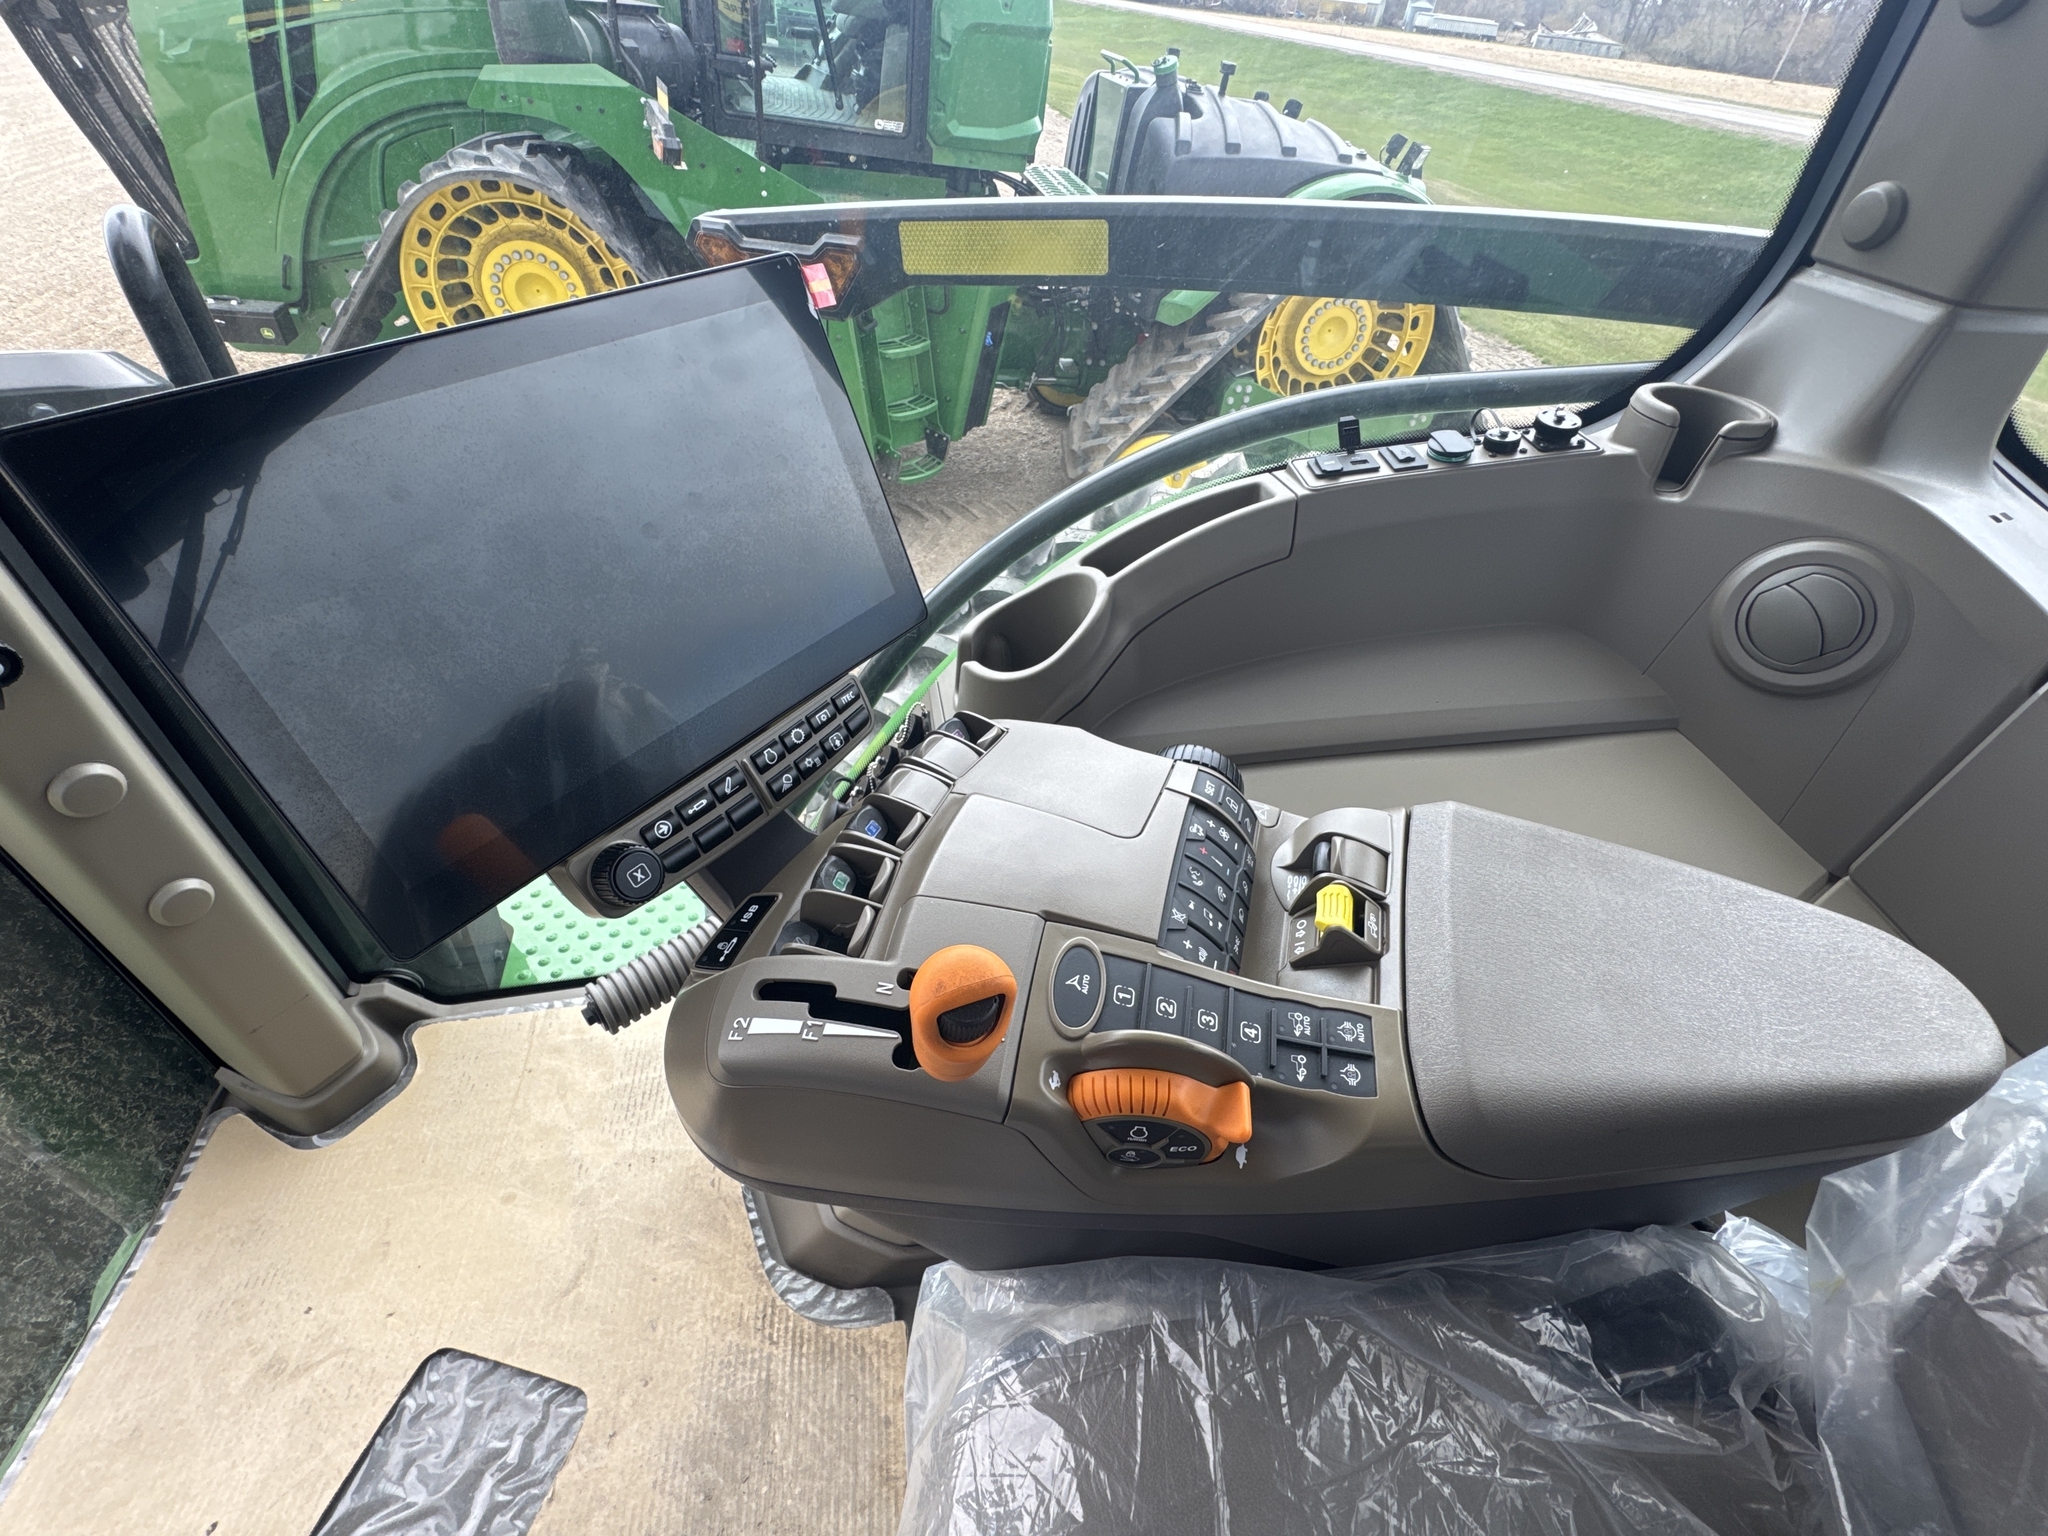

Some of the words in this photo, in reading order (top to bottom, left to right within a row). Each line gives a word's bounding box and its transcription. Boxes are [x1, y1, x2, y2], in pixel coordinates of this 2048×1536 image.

[1204, 780, 1216, 796] SET
[740, 904, 759, 923] ISB
[876, 982, 895, 995] N
[1081, 974, 1090, 994] AUTO
[1117, 992, 1131, 1000] 1
[1159, 1002, 1173, 1014] 2
[1201, 1015, 1215, 1026] 3
[1303, 1015, 1311, 1036] AUTO
[727, 1017, 750, 1041] F2
[801, 1020, 824, 1041] F1
[1243, 1028, 1258, 1039] 4
[1358, 1023, 1366, 1043] AUTO
[1169, 1145, 1198, 1153] ECO
